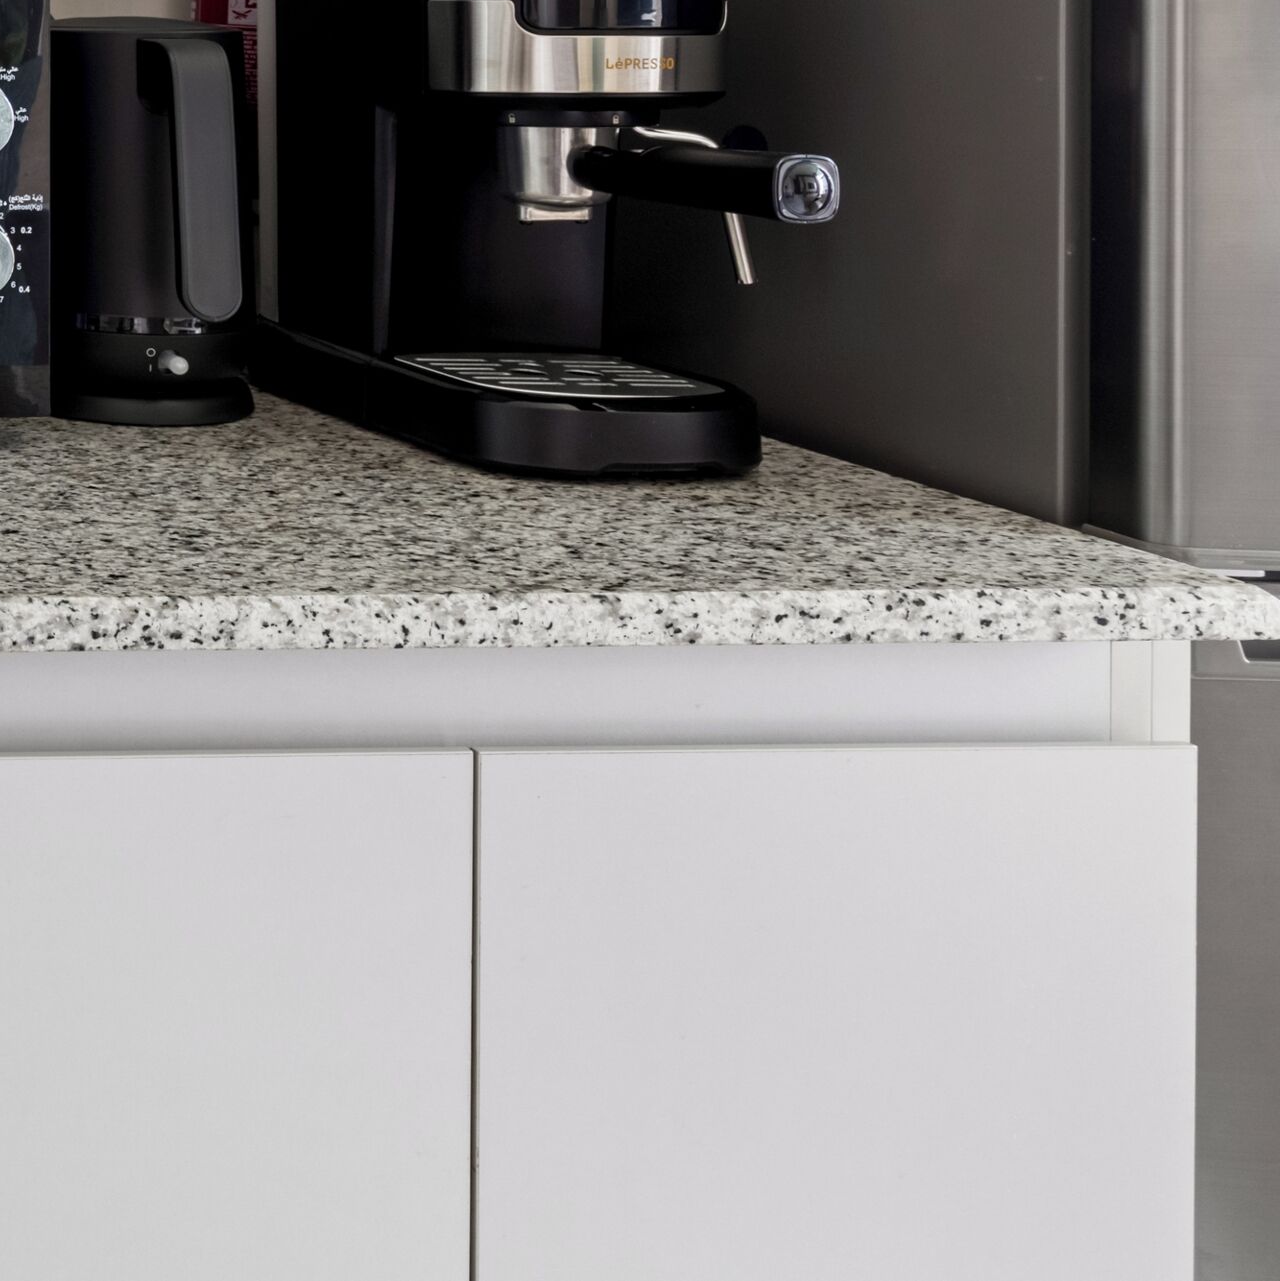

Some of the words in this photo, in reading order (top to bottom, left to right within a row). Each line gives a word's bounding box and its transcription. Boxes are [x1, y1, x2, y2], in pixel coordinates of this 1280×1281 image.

[8, 203, 43, 212] Defrost(Kg)
[20, 226, 32, 234] 0.2
[10, 281, 16, 289] 6
